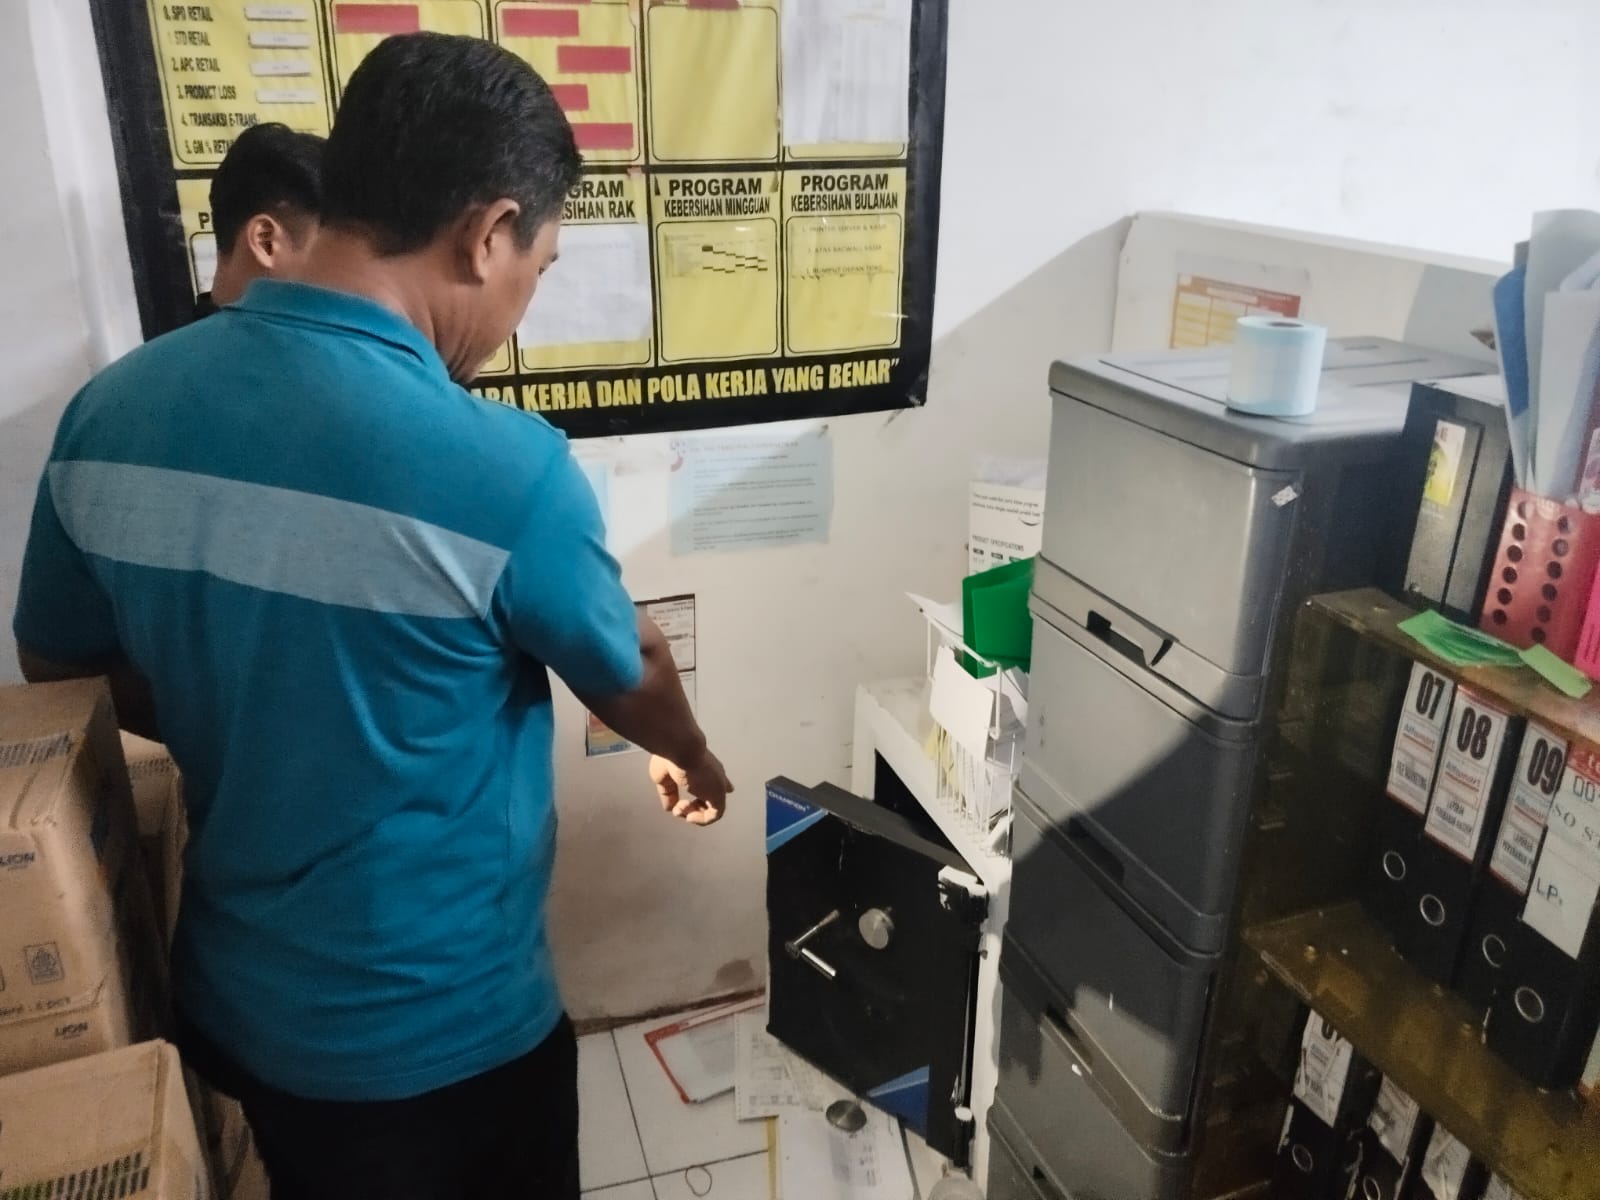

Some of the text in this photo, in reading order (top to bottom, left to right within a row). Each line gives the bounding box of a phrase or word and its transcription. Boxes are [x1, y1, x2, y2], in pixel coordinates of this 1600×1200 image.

[187, 6, 213, 22] RETAIL
[188, 31, 211, 46] RETAIL
[180, 57, 194, 72] APC
[195, 57, 221, 72] RETAIL
[184, 85, 216, 99] PRODUCT
[218, 86, 237, 99] LOSS
[189, 113, 227, 127] TRANSAKSI
[669, 178, 762, 196] PROGRAM
[801, 174, 888, 192] PROGRAM
[561, 200, 636, 220] SIHAN RAK
[664, 197, 770, 217] KEBERSIHAN MINGGUAN
[791, 192, 898, 212] KEBERSIHAN BULANAN
[522, 381, 592, 412] KERJA
[596, 379, 642, 407] DAN
[648, 374, 701, 404] POLA
[705, 369, 768, 399] KERJA
[772, 362, 824, 393] YANG
[1416, 671, 1446, 720] 07
[1457, 707, 1492, 760] 08
[1527, 738, 1563, 795] 09
